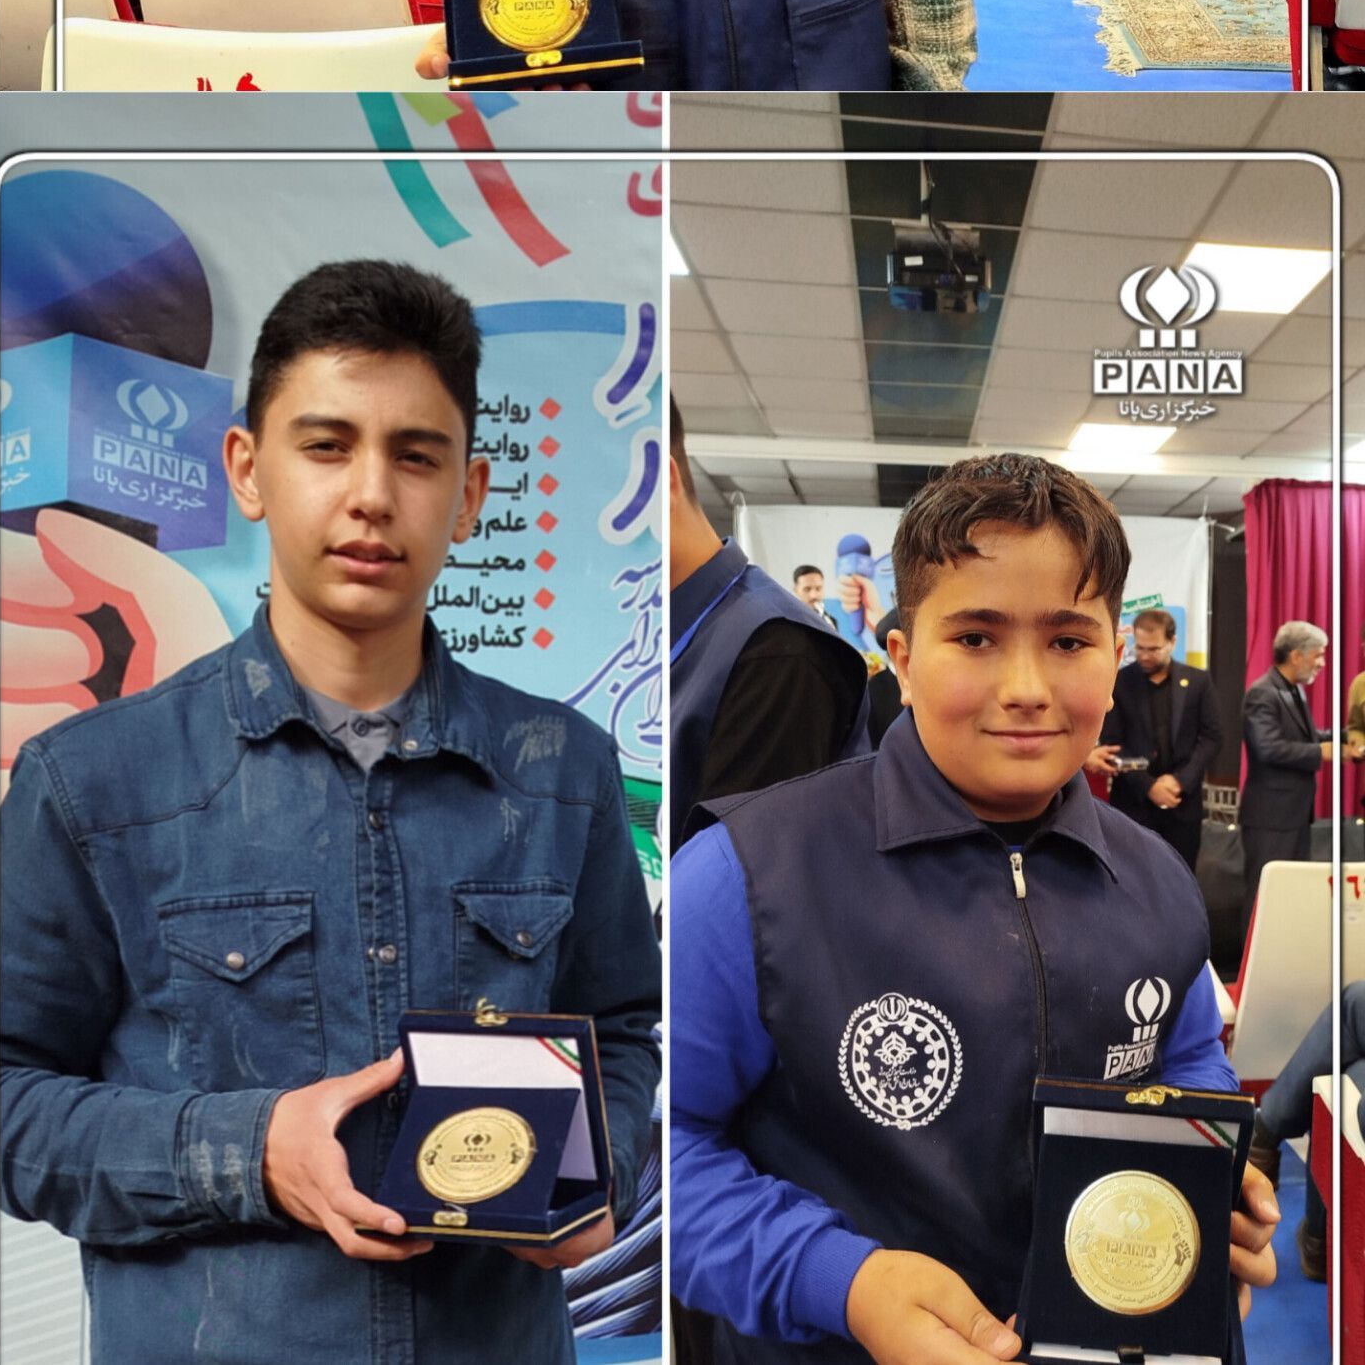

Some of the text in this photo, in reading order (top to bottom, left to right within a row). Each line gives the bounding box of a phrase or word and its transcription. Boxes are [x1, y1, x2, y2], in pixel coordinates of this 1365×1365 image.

[515, 1, 555, 11] PANA
[94, 435, 206, 488] PANA
[93, 465, 207, 510] خبرگزاری پانا
[485, 510, 527, 539] علم
[480, 594, 525, 618] بین
